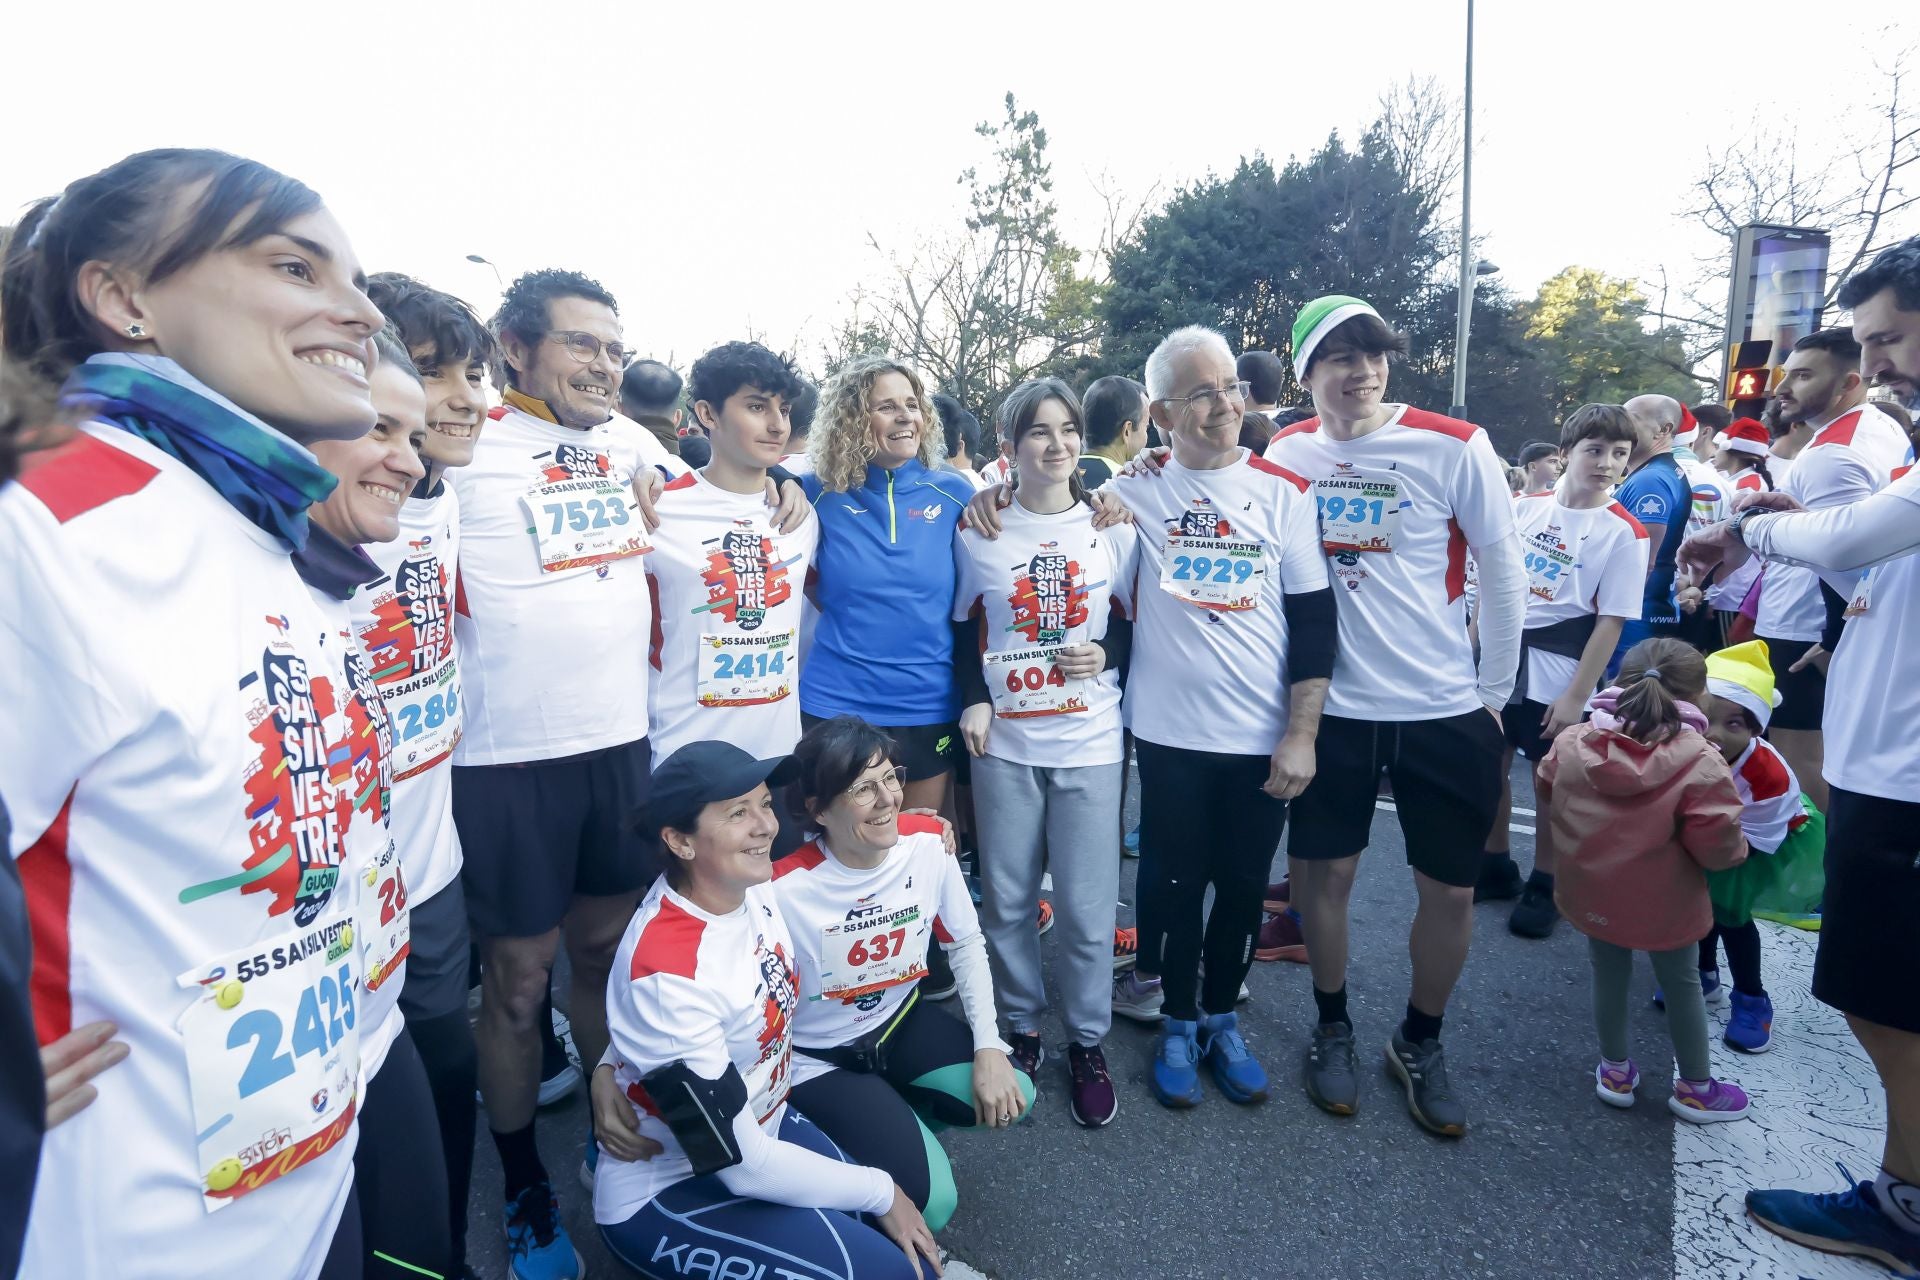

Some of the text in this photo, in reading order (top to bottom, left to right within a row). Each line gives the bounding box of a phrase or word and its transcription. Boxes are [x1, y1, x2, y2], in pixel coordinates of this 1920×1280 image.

[564, 455, 600, 474] SAN
[541, 487, 556, 495] 55
[555, 484, 577, 493] SAN
[1318, 480, 1397, 492] 55 SAN SILVESTRE
[543, 497, 630, 536] 7523
[1197, 513, 1218, 528] 55
[1186, 521, 1216, 538] SAN
[729, 541, 762, 558] SAN
[742, 534, 761, 547] 55
[1183, 540, 1262, 553] 55 SAN SILVESTRE
[1541, 545, 1574, 561] SILVESTRE
[419, 559, 439, 582] 55
[733, 557, 763, 573] SIL
[1035, 565, 1066, 580] SAN
[1046, 557, 1066, 570] 55
[1172, 556, 1253, 584] 2929
[405, 577, 442, 601] SAN
[735, 573, 765, 590] VES
[1037, 580, 1065, 597] SIL
[735, 589, 766, 611] TRE
[1038, 596, 1067, 612] VES
[411, 598, 445, 624] SIL
[1037, 612, 1067, 630] TRE
[413, 619, 446, 647] VES
[722, 633, 790, 646] 55 SAN SILVESTRE
[713, 651, 785, 679] 2414
[1002, 655, 1013, 663] 55
[1014, 652, 1031, 661] SAN
[396, 679, 420, 697] SAN
[421, 657, 456, 688] SILVESTRE
[1006, 663, 1067, 693] 604
[290, 767, 338, 817] VES
[290, 811, 340, 866] TRE
[844, 904, 919, 933] 55 SAN SILVESTRE
[847, 927, 906, 967] 637
[237, 954, 270, 983] 55
[272, 938, 309, 970] SAN
[226, 962, 356, 1100] 2425
